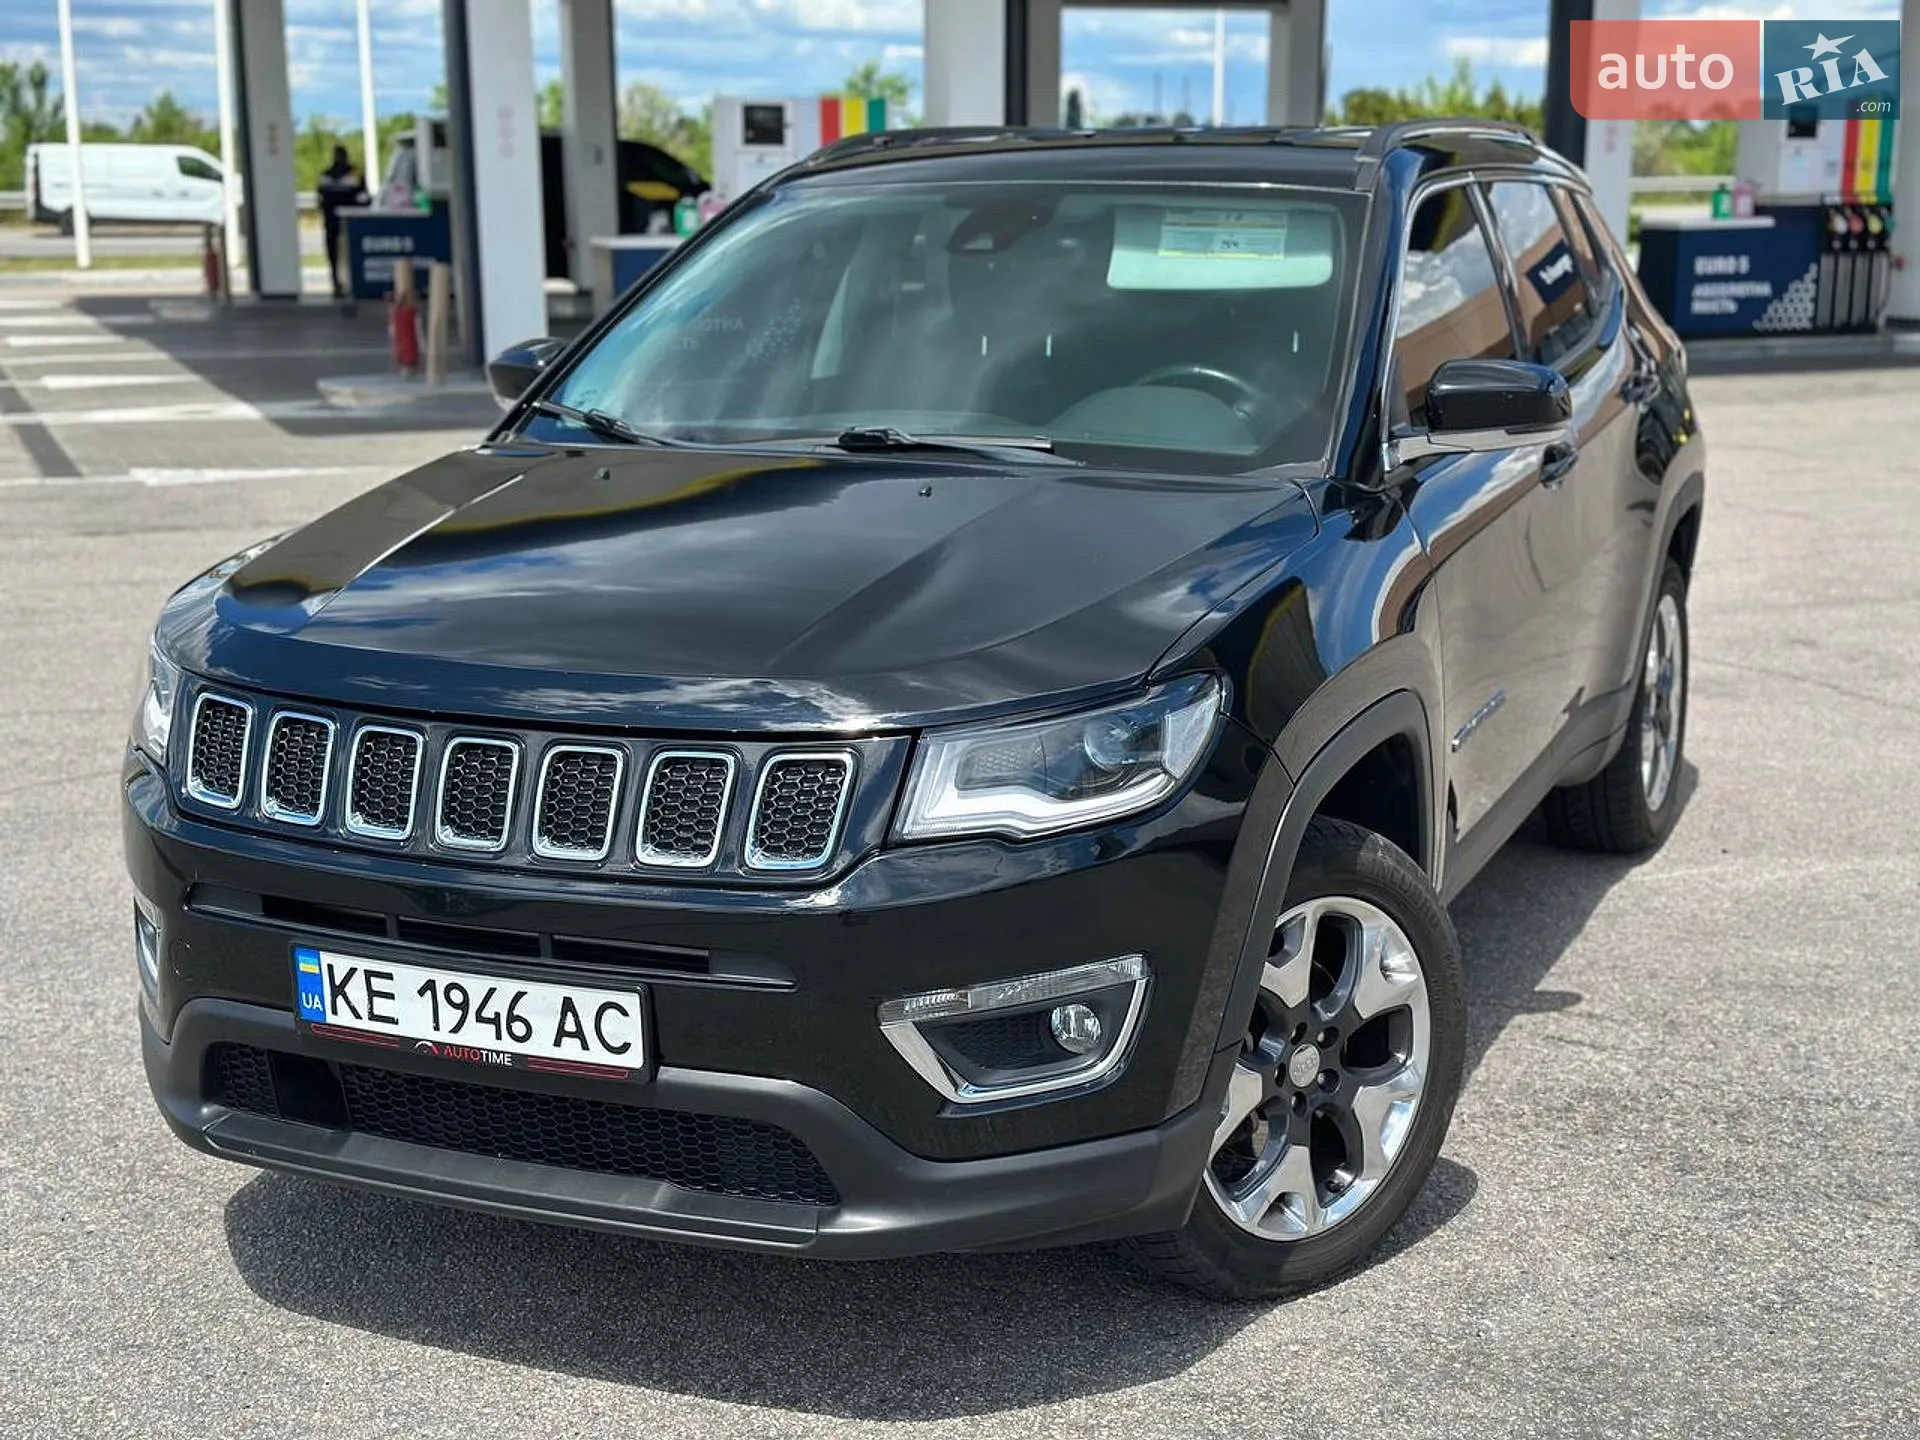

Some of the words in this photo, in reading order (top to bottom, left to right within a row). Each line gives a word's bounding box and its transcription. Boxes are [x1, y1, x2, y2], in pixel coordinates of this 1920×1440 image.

[1693, 255, 1737, 276] EURO
[301, 992, 324, 1012] UA
[326, 963, 399, 1025] KE
[416, 978, 533, 1044] 1946
[552, 995, 633, 1055] AC
[443, 1044, 513, 1067] AUTOTIME
